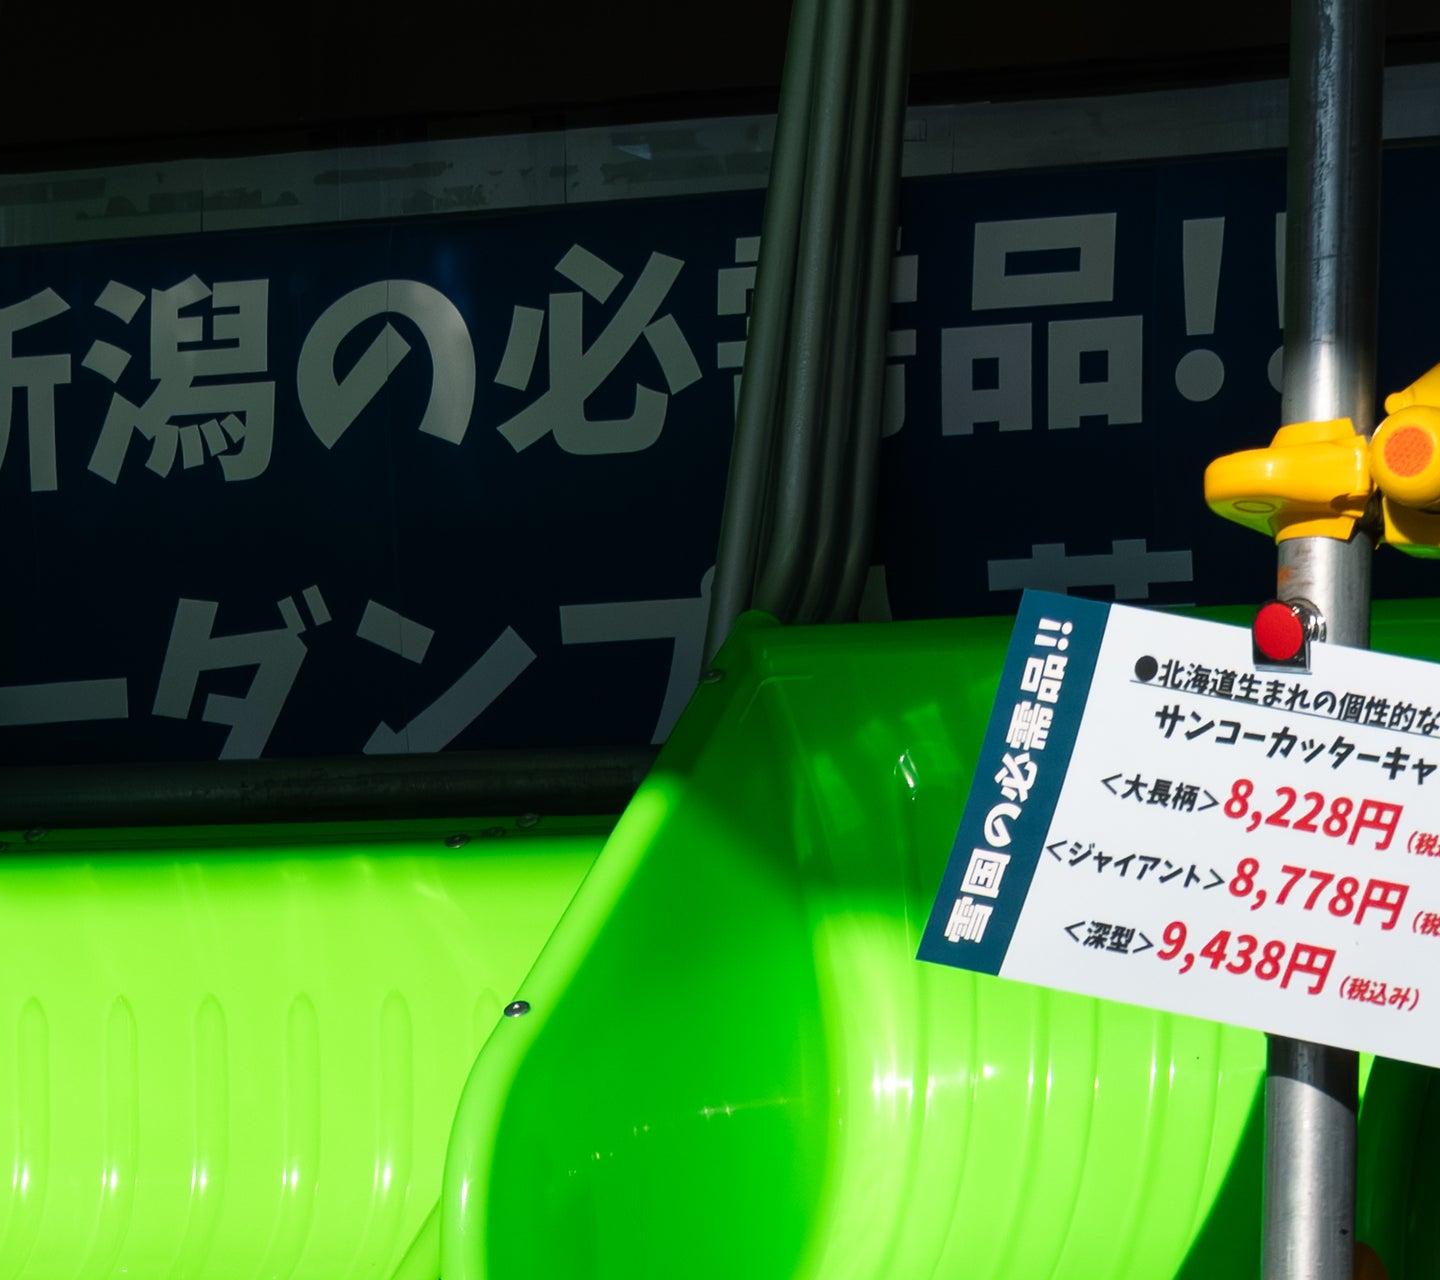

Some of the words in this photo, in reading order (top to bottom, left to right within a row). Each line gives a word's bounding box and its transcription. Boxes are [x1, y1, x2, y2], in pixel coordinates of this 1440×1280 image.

[944, 617, 1074, 944] 雪国の必需品!!
[1223, 778, 1404, 851] 8,228円
[1228, 856, 1410, 932] 8,778円
[1156, 920, 1337, 996] 9,438円
[1338, 975, 1420, 1011] (税込み)
